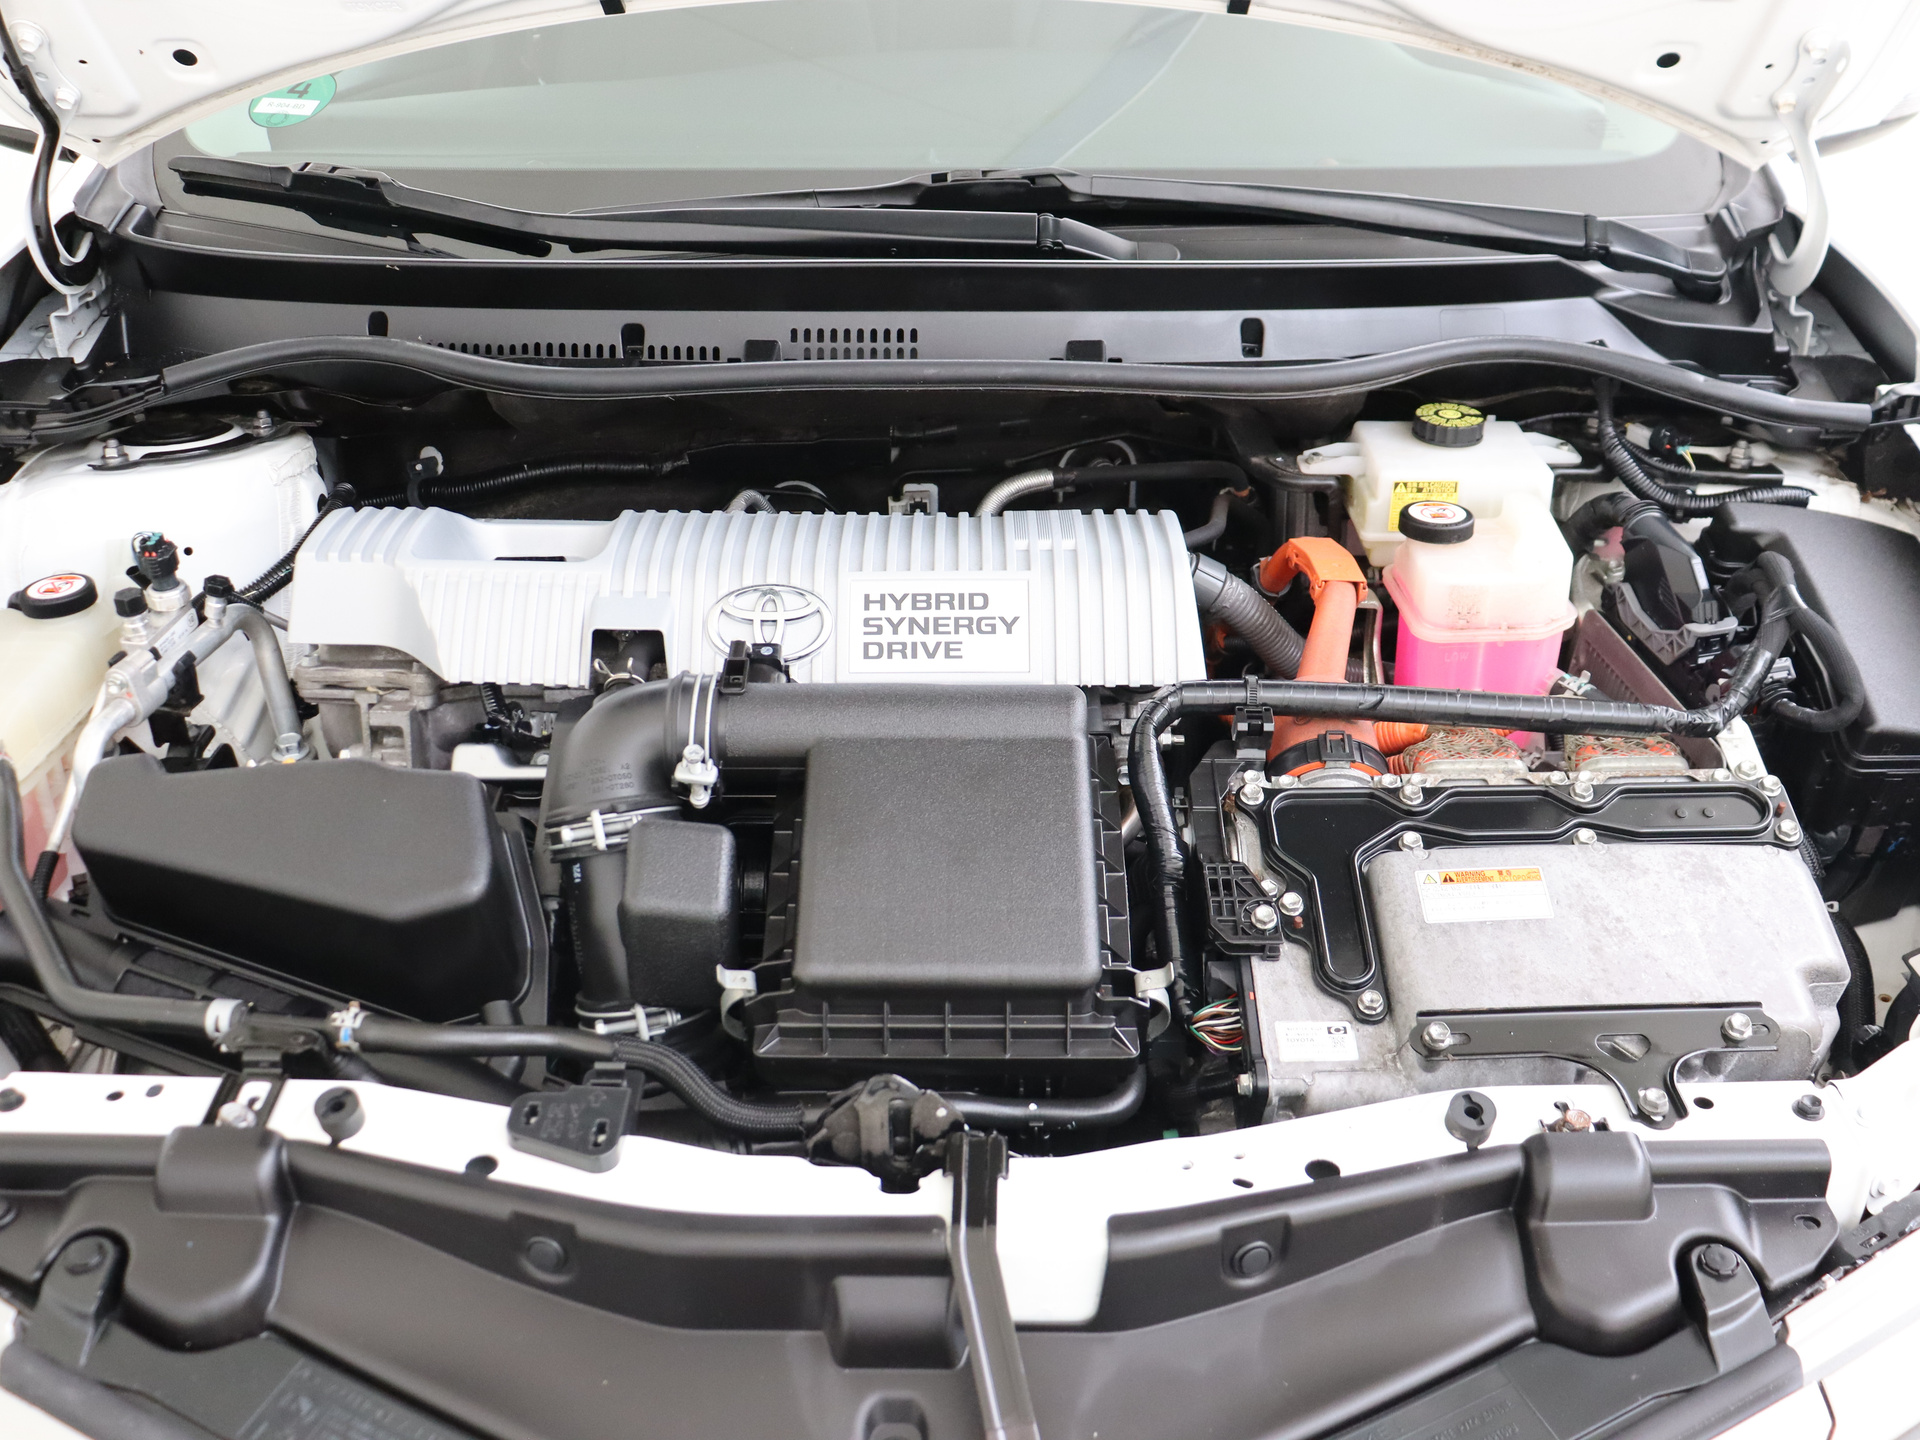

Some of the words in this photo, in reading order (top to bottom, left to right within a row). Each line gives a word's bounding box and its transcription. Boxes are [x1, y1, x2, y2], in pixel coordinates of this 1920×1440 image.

[343, 0, 402, 12] TOYOTA
[287, 80, 312, 98] 4
[863, 593, 989, 611] HYBRID
[863, 616, 1020, 635] SYNERGY
[863, 641, 963, 660] DRIVE
[1444, 652, 1469, 662] LOW
